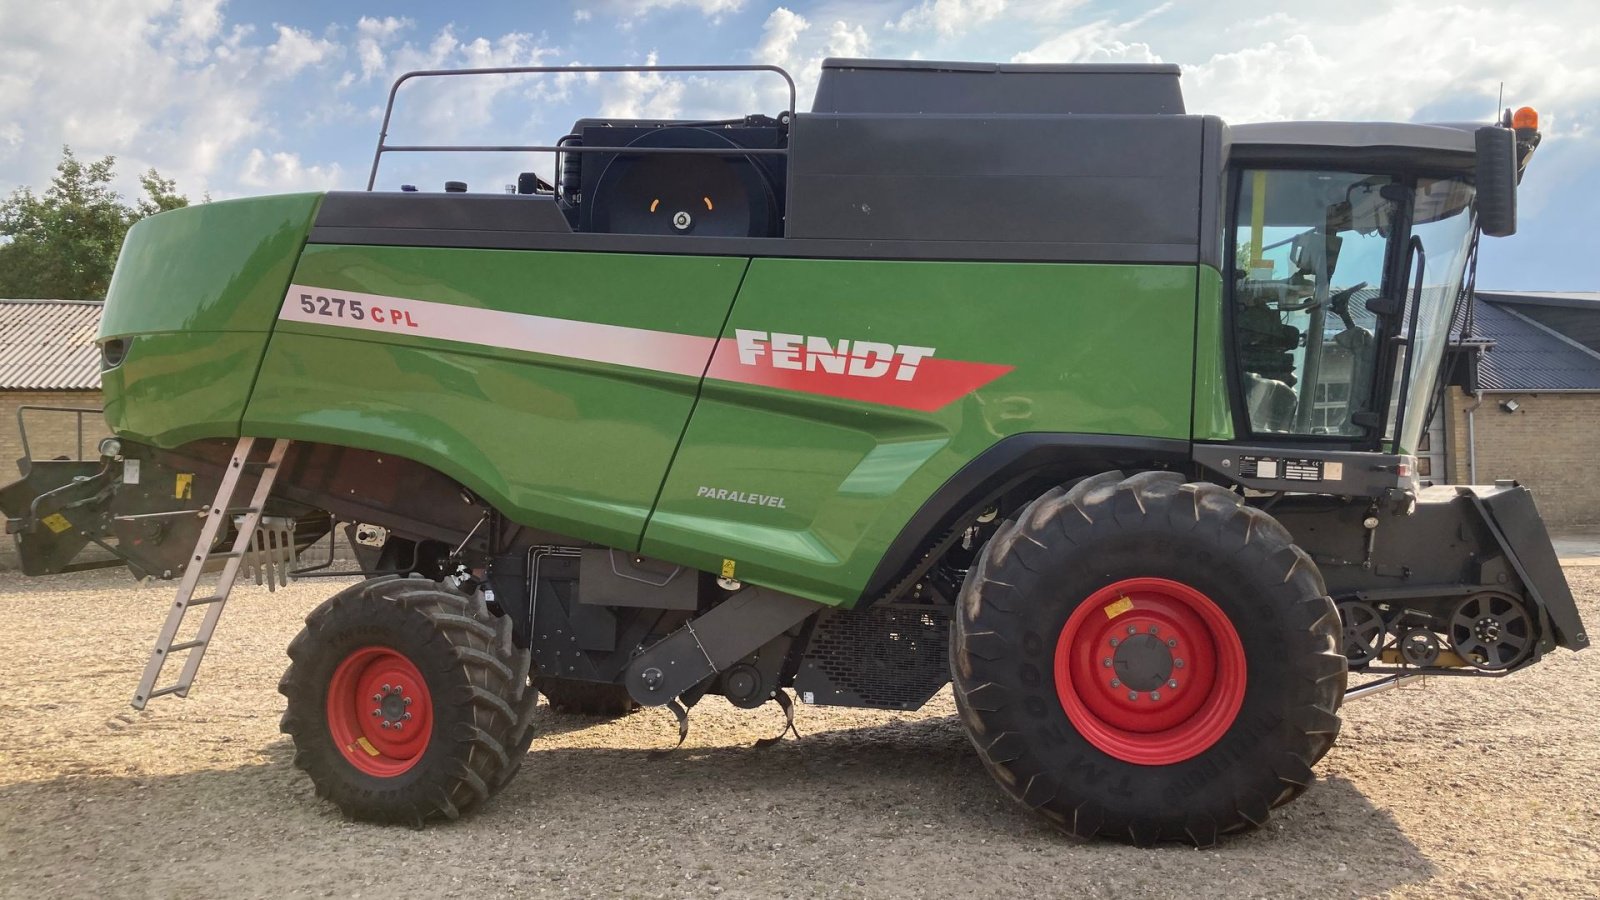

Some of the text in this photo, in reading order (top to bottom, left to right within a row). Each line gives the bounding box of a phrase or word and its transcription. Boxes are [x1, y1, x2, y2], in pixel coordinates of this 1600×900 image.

[300, 294, 418, 327] 5275 C PL
[735, 328, 936, 381] FENDT
[696, 486, 786, 508] PARALEVEL
